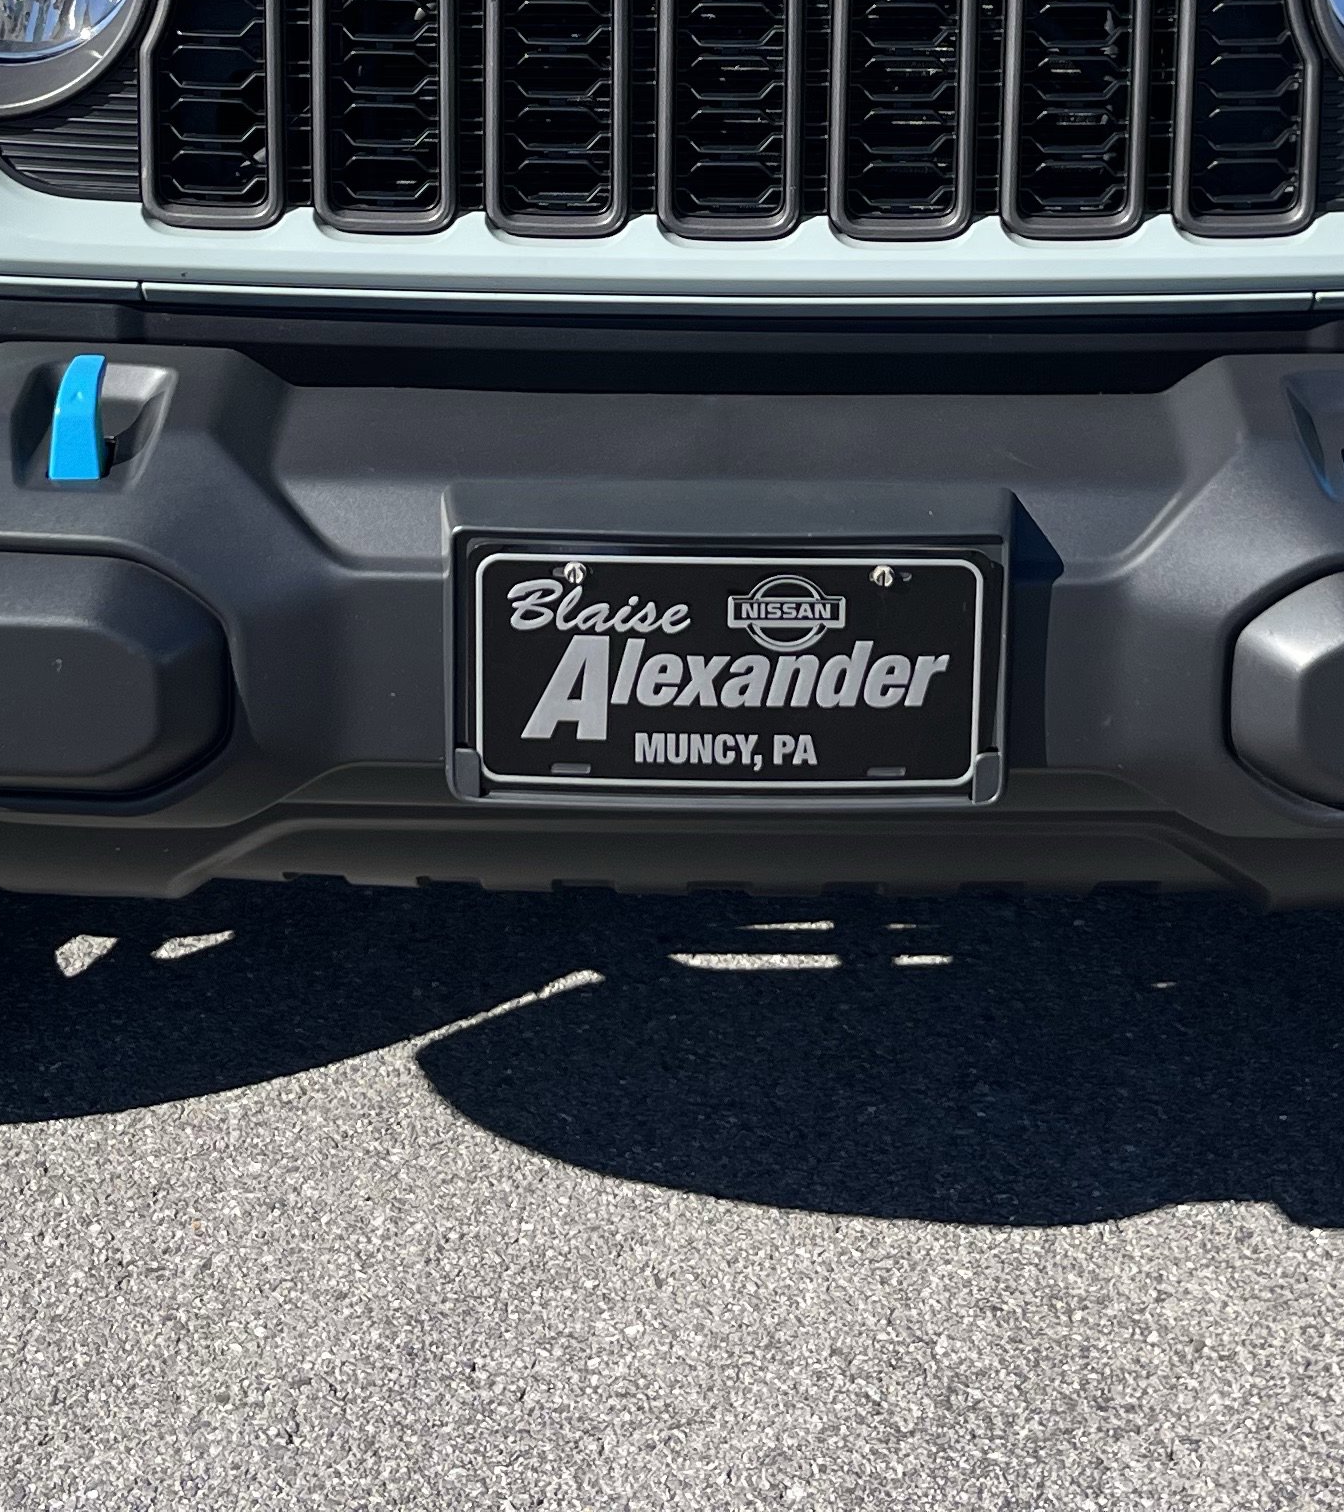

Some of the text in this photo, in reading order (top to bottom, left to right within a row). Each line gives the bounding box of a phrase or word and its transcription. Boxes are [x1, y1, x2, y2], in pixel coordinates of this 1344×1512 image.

[507, 578, 691, 634] Blaise
[741, 602, 832, 619] NISSAN
[520, 635, 950, 740] Alexander
[635, 732, 818, 771] MUNCY, PA
